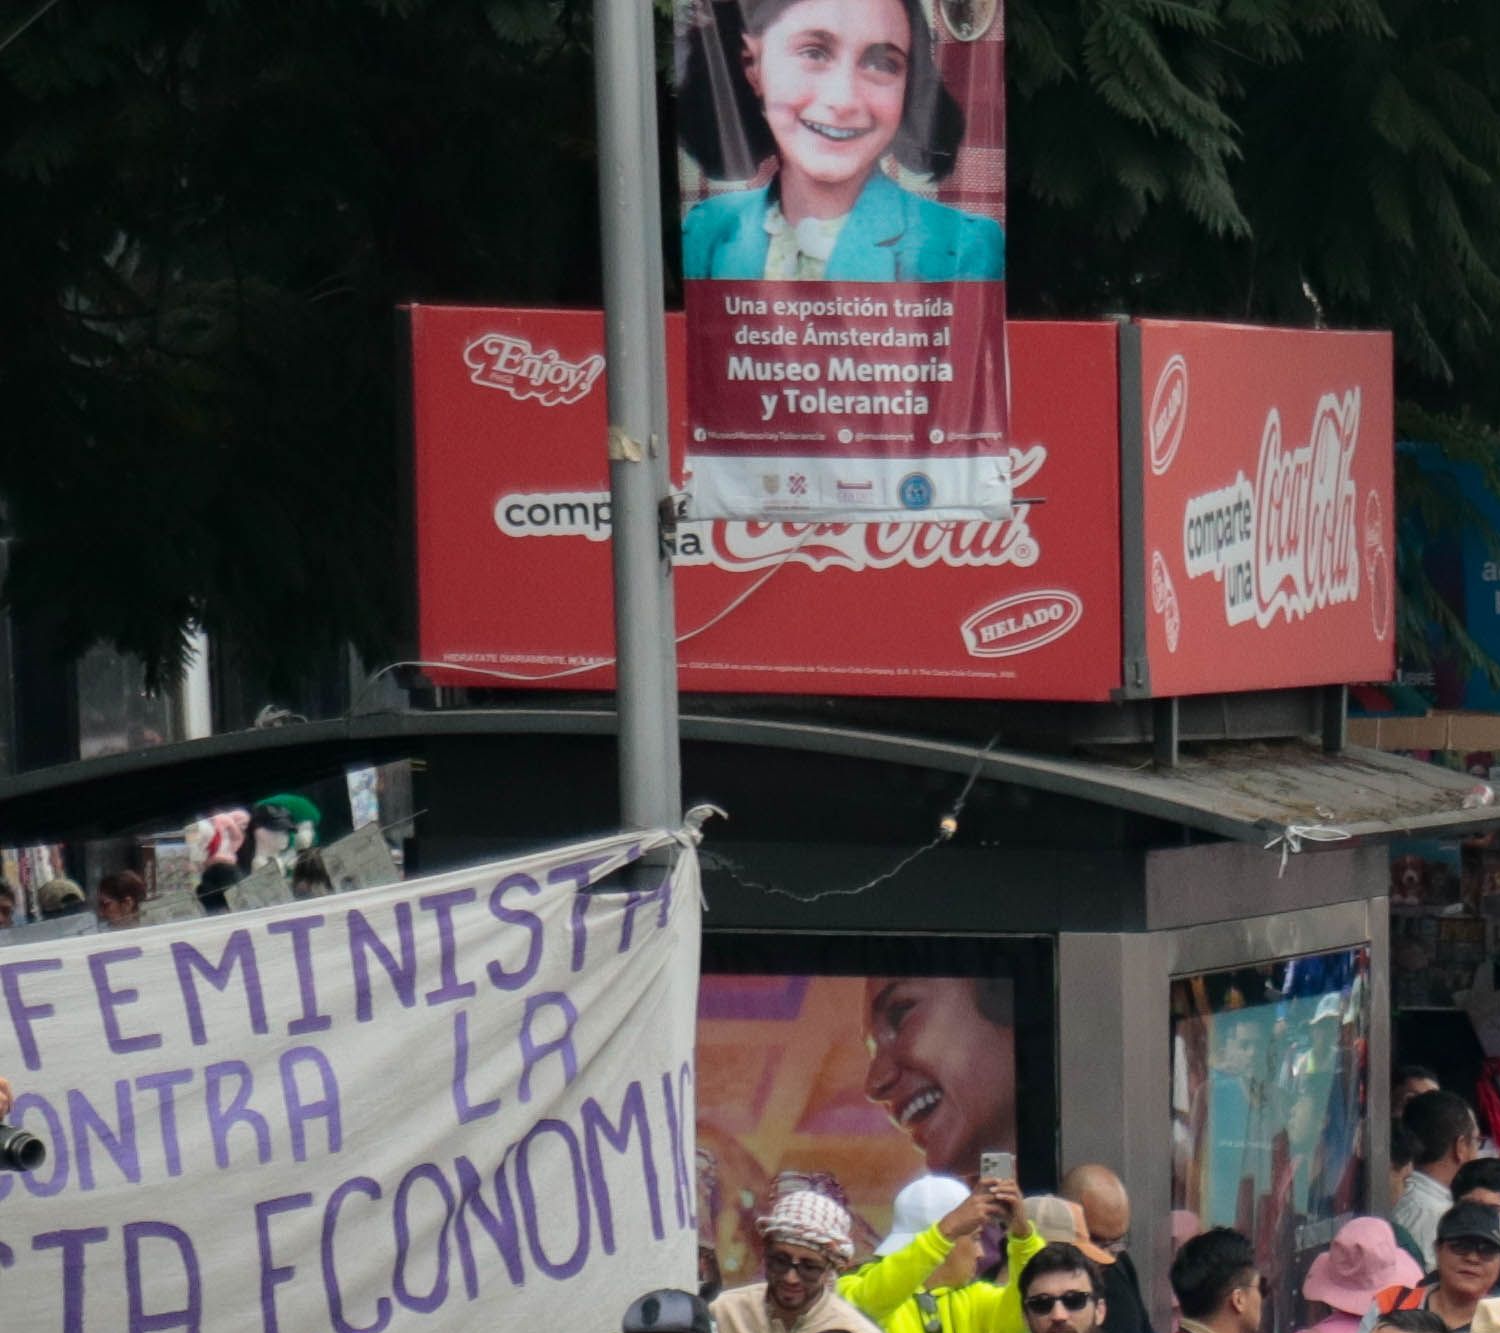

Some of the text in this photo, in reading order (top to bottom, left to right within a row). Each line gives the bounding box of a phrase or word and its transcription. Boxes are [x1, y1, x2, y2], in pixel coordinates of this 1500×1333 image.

[725, 297, 954, 320] Una exposición traída
[735, 323, 950, 347] desde Ámsterdam al
[484, 339, 603, 392] Enjoy!
[728, 357, 953, 383] Museo Memoria
[762, 389, 929, 420] y Tolerancia
[1187, 495, 1252, 562] comparte
[1227, 561, 1253, 607] una
[978, 603, 1065, 644] HELADO
[452, 991, 579, 1125] LA
